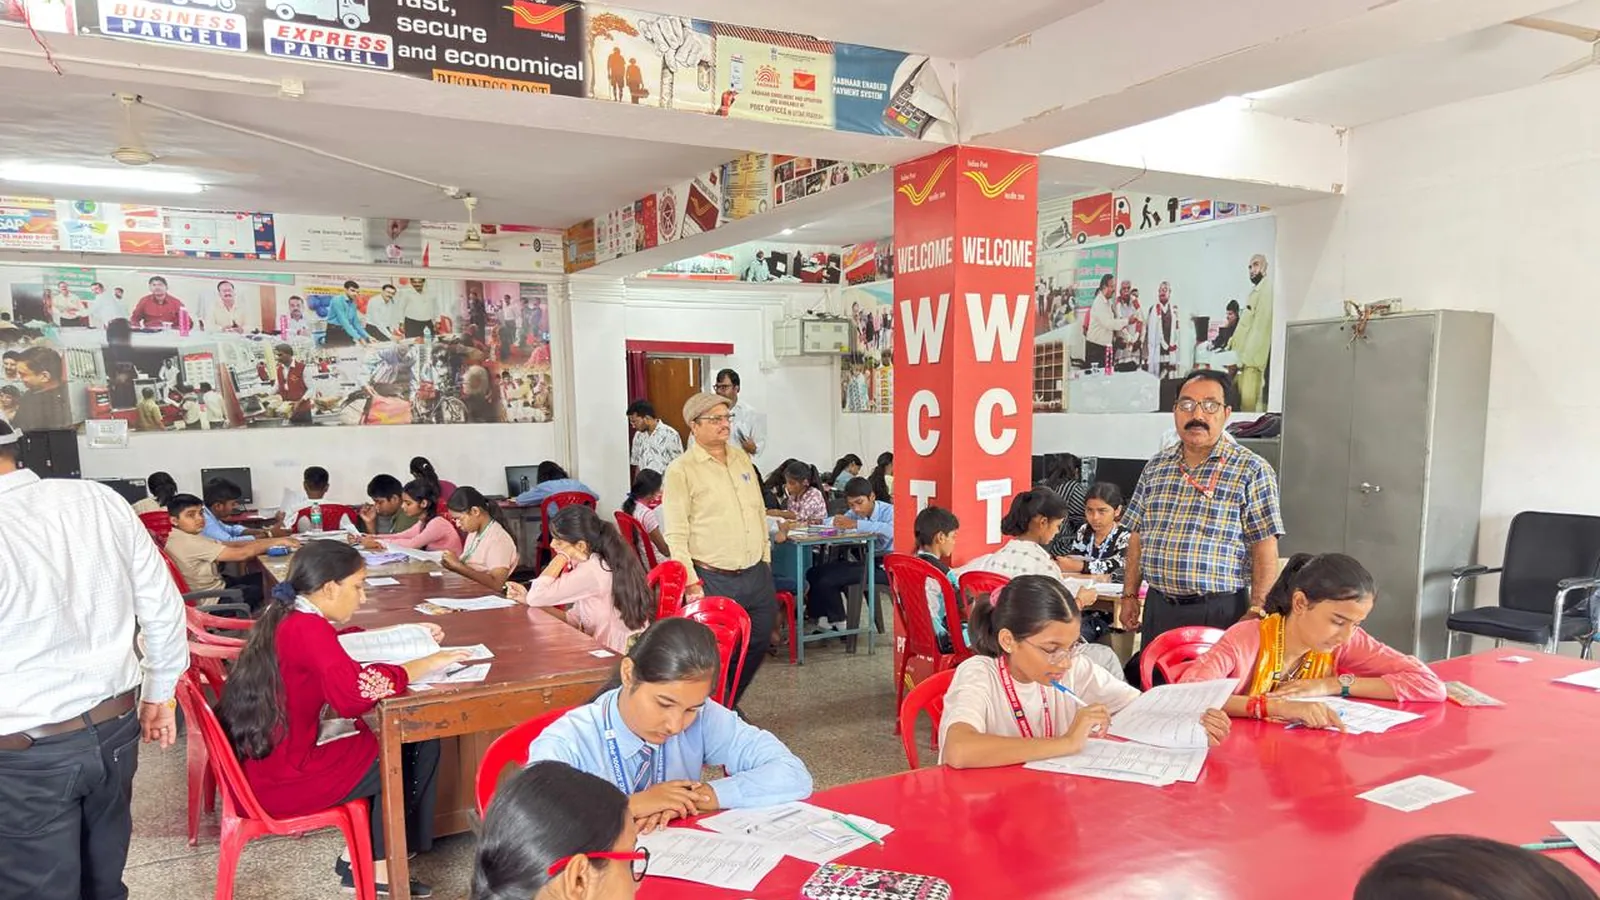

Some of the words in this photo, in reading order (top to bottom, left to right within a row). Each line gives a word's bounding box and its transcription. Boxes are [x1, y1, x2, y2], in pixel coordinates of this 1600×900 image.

[114, 3, 236, 31] BUSINESS
[397, 0, 456, 17] ast,
[122, 19, 227, 46] PARCEL
[277, 25, 387, 51] EXPRESS
[397, 16, 487, 43] secure
[284, 42, 376, 65] PARCEL
[398, 44, 437, 61] and
[445, 49, 584, 81] economical
[832, 86, 860, 97] PAYMENT
[860, 90, 883, 100] SYSTEM
[750, 103, 764, 111] POST
[897, 236, 954, 275] WELCOME
[962, 236, 1033, 268] WELCOME
